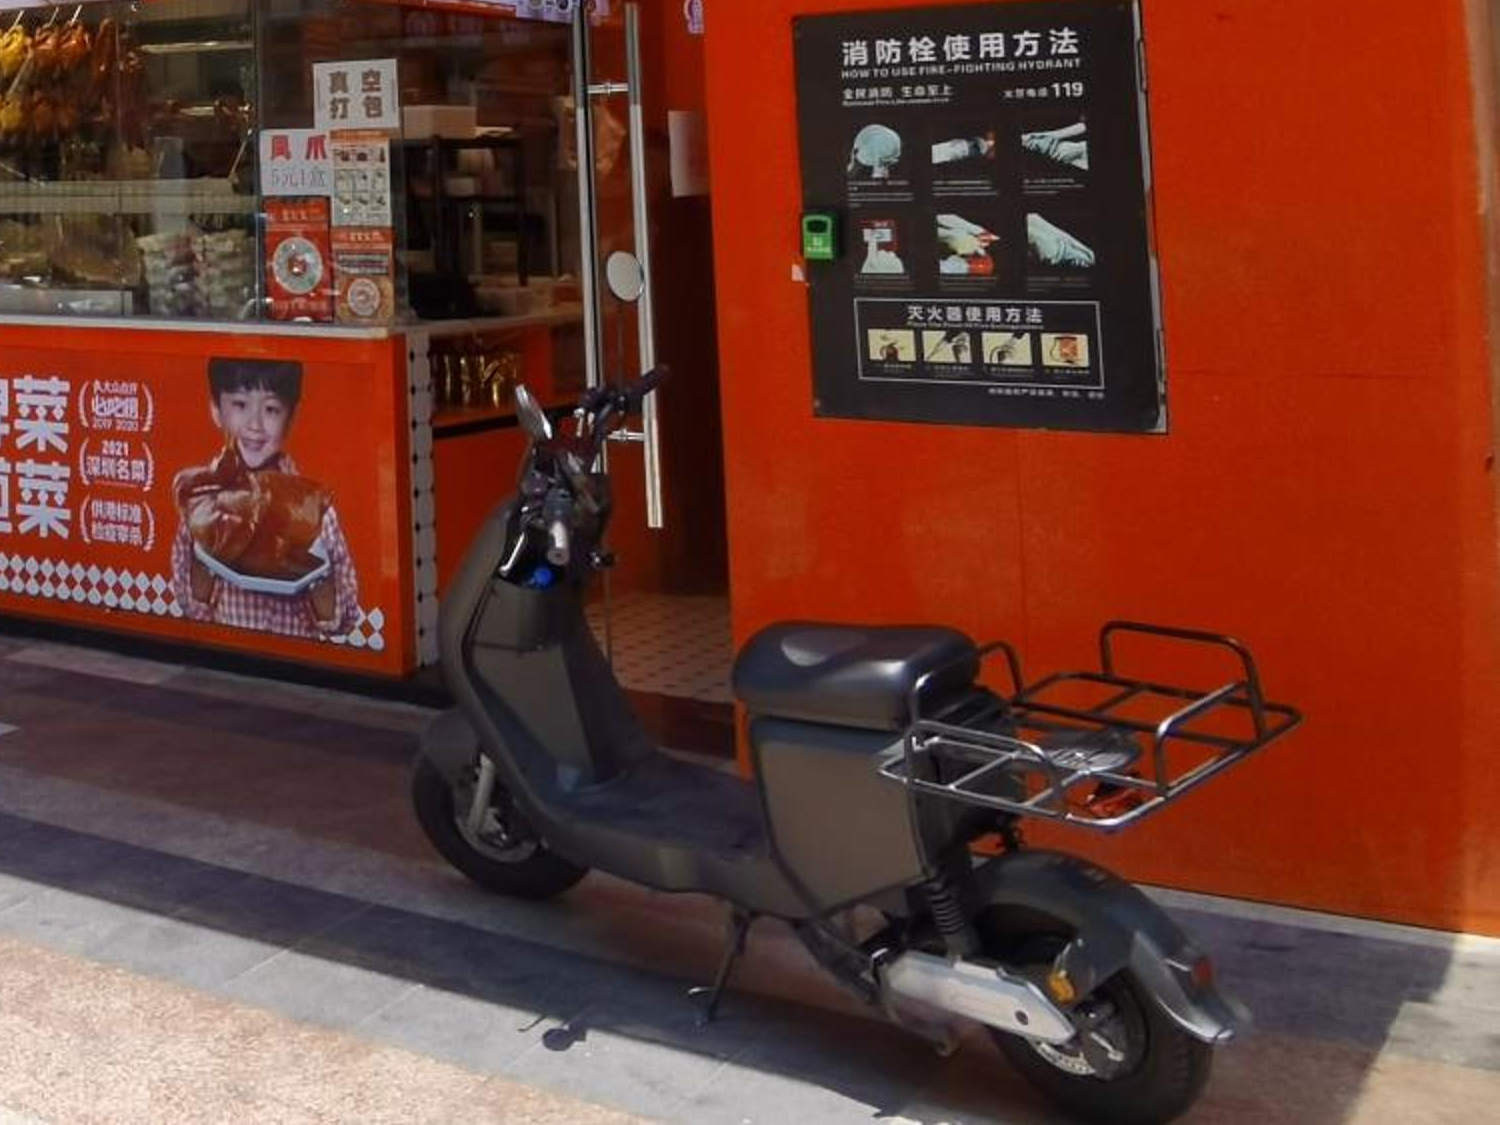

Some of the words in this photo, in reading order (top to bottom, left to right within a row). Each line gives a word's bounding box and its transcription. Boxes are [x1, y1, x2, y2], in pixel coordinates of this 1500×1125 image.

[842, 27, 1079, 67] 消防栓使用方法
[841, 68, 869, 79] HOW
[873, 68, 888, 77] TO
[892, 66, 915, 77] USE
[1018, 58, 1081, 70] HYDRANT
[329, 69, 382, 94] 真空
[1051, 82, 1084, 98] 119
[329, 96, 383, 120] 打包
[102, 439, 129, 456] 2021
